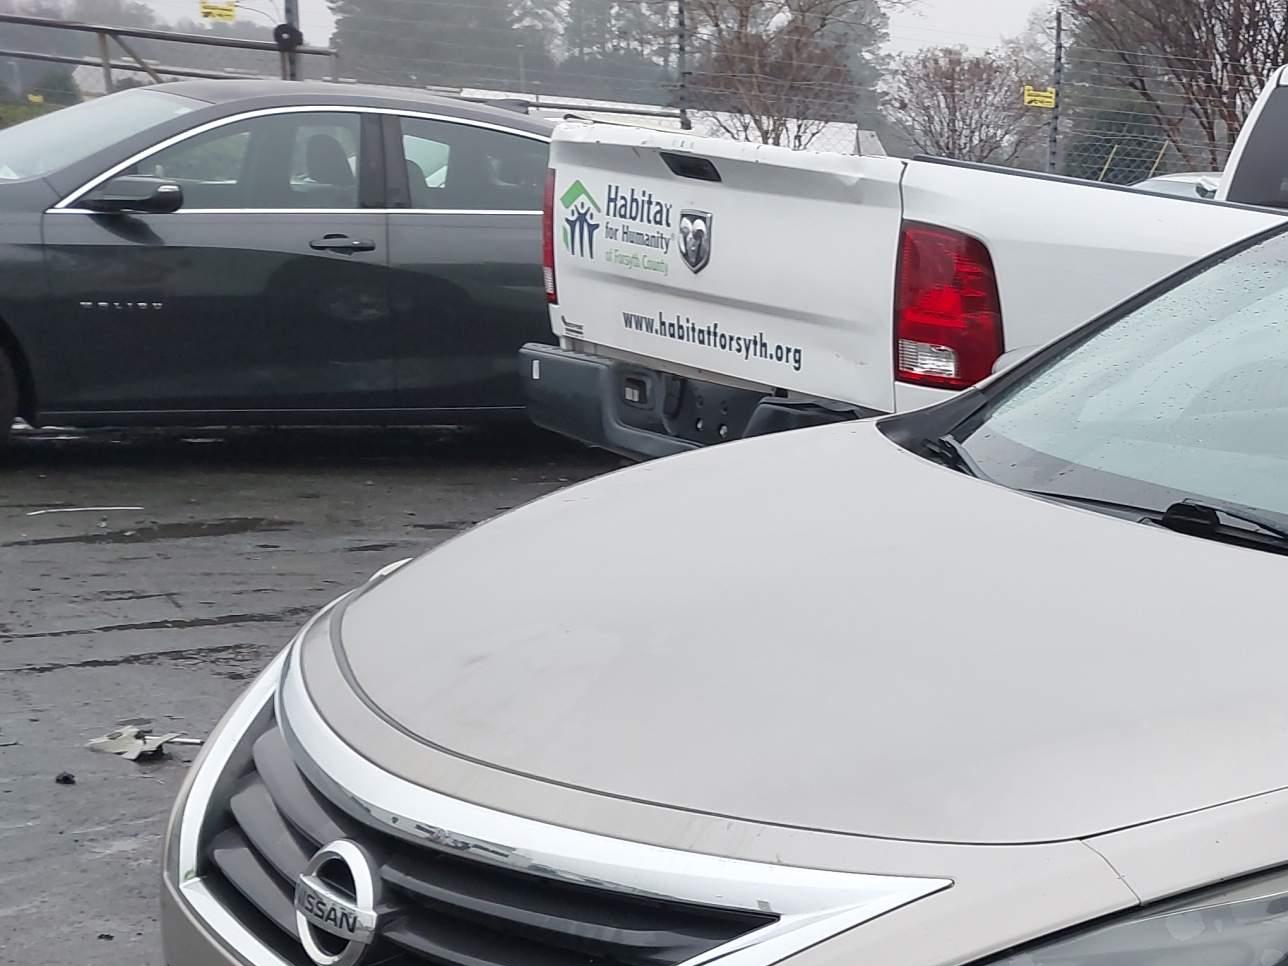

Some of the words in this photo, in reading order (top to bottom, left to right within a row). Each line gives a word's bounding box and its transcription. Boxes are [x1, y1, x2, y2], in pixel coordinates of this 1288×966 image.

[605, 184, 672, 228] Habitat
[605, 221, 619, 240] for
[622, 223, 671, 254] Humanity
[622, 311, 803, 371] www.habitatforsyth.org
